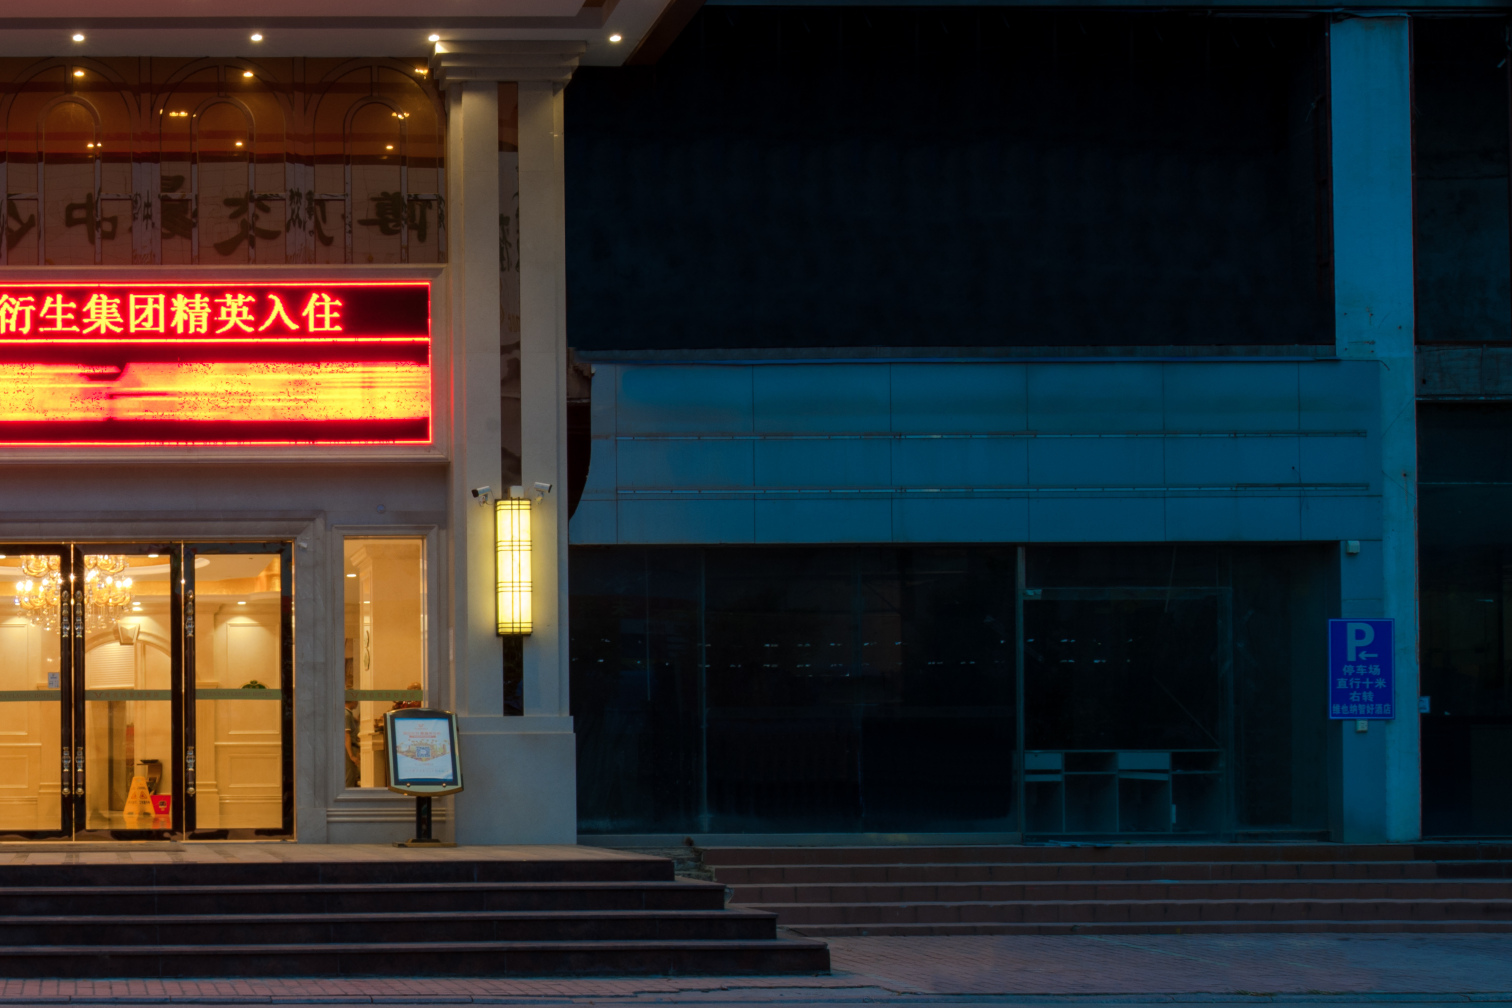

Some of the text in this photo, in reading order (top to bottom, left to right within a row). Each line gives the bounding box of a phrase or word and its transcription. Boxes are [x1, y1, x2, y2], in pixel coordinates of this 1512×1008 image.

[1346, 622, 1375, 662] P
[1342, 664, 1381, 676] 停车场
[1336, 677, 1387, 689] 直行十米
[1349, 690, 1374, 702] 右转
[1332, 703, 1392, 715] 维也纳智好酒店
